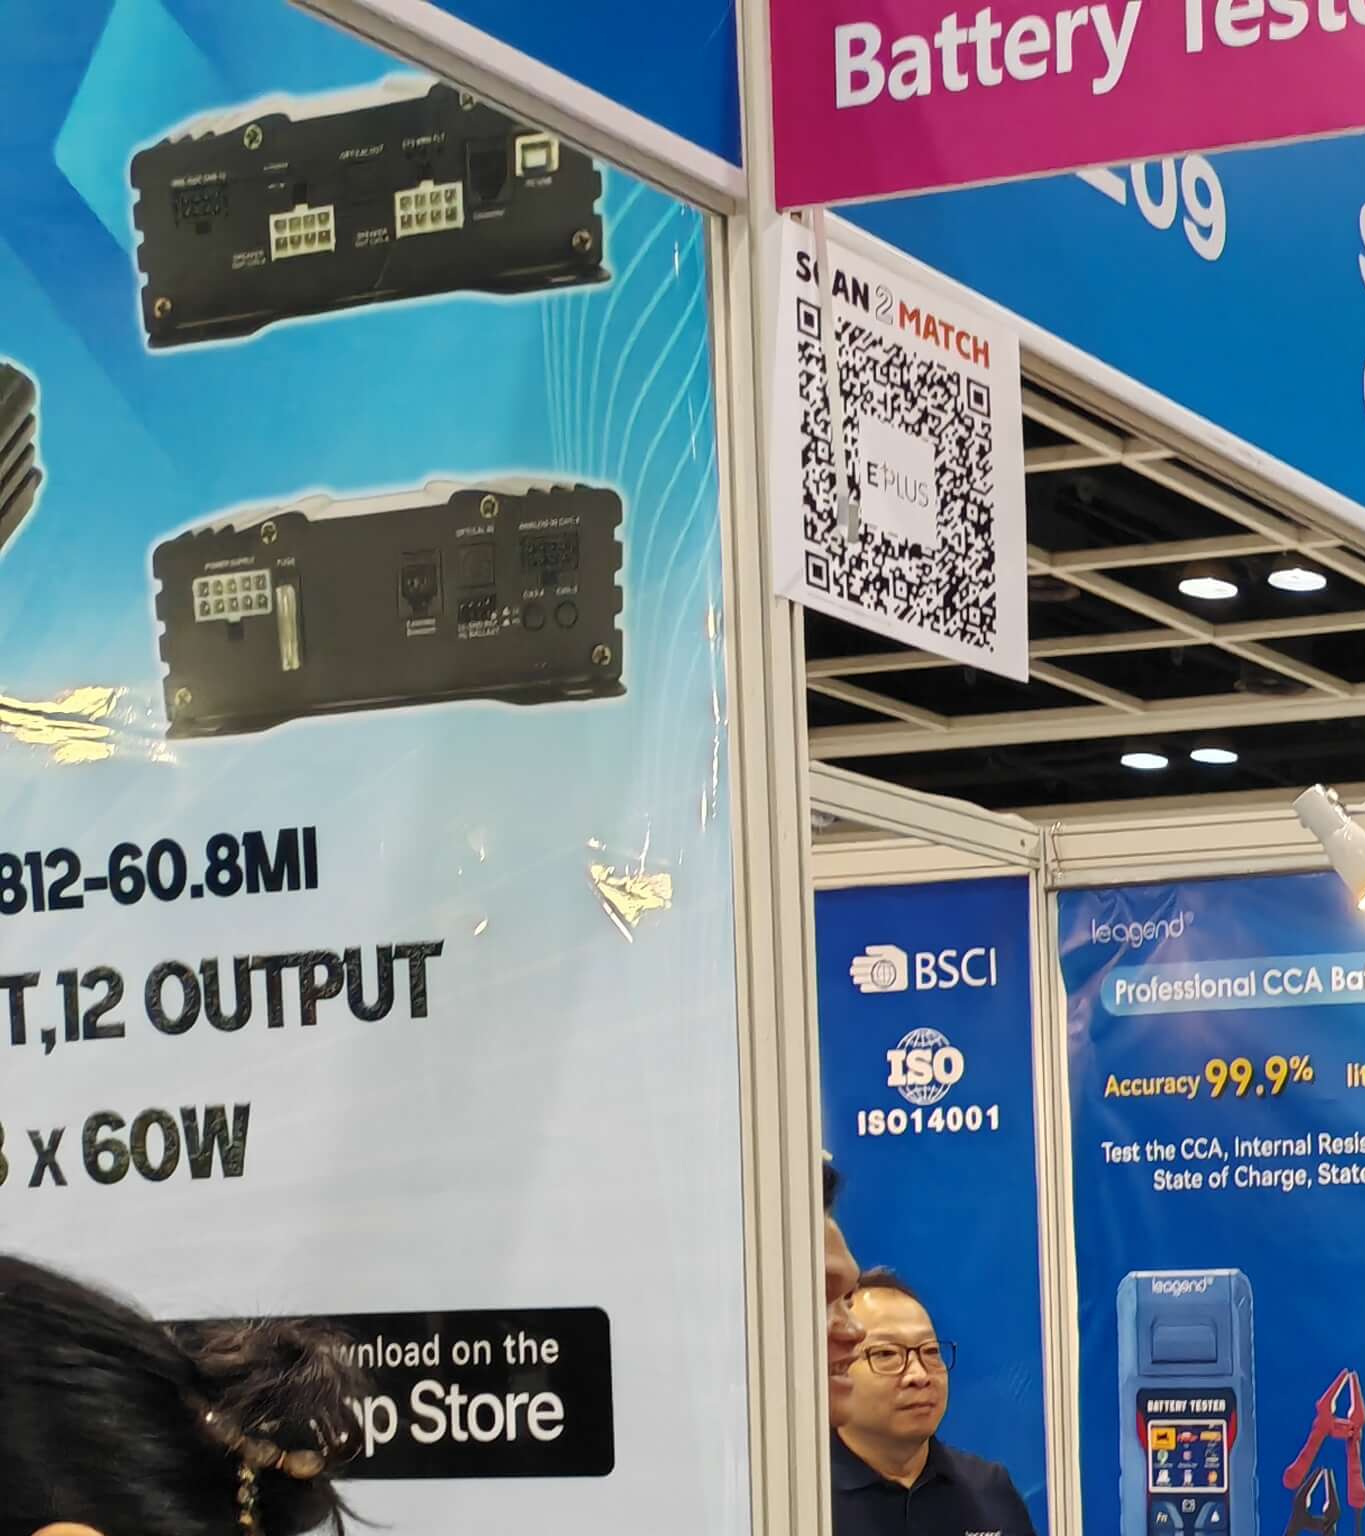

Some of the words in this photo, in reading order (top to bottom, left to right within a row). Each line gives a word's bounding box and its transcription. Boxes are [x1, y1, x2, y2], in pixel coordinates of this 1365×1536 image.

[833, 0, 1143, 109] Battery
[1075, 154, 1227, 261] 09
[796, 251, 869, 313] SAN
[899, 300, 990, 369] MATCH
[145, 938, 444, 1035] OUTPUT
[915, 947, 997, 990] BSCI
[1114, 971, 1256, 1006] Professional
[1263, 968, 1323, 997] CCA
[886, 1046, 965, 1087] ISO
[1104, 1072, 1200, 1101] Accuracy
[1204, 1054, 1313, 1100] 99.9%
[857, 1104, 999, 1136] ISO14001
[82, 1101, 251, 1185] 60W
[1101, 1140, 1142, 1164] Test
[1145, 1137, 1176, 1162] the
[1180, 1136, 1230, 1163] CCA,
[1234, 1133, 1312, 1158] Internal
[1153, 1167, 1202, 1192] State
[1208, 1165, 1230, 1188] of
[1234, 1163, 1313, 1193] Charge,
[452, 1339, 491, 1365] on
[503, 1331, 559, 1364] the
[410, 1379, 565, 1444] Store
